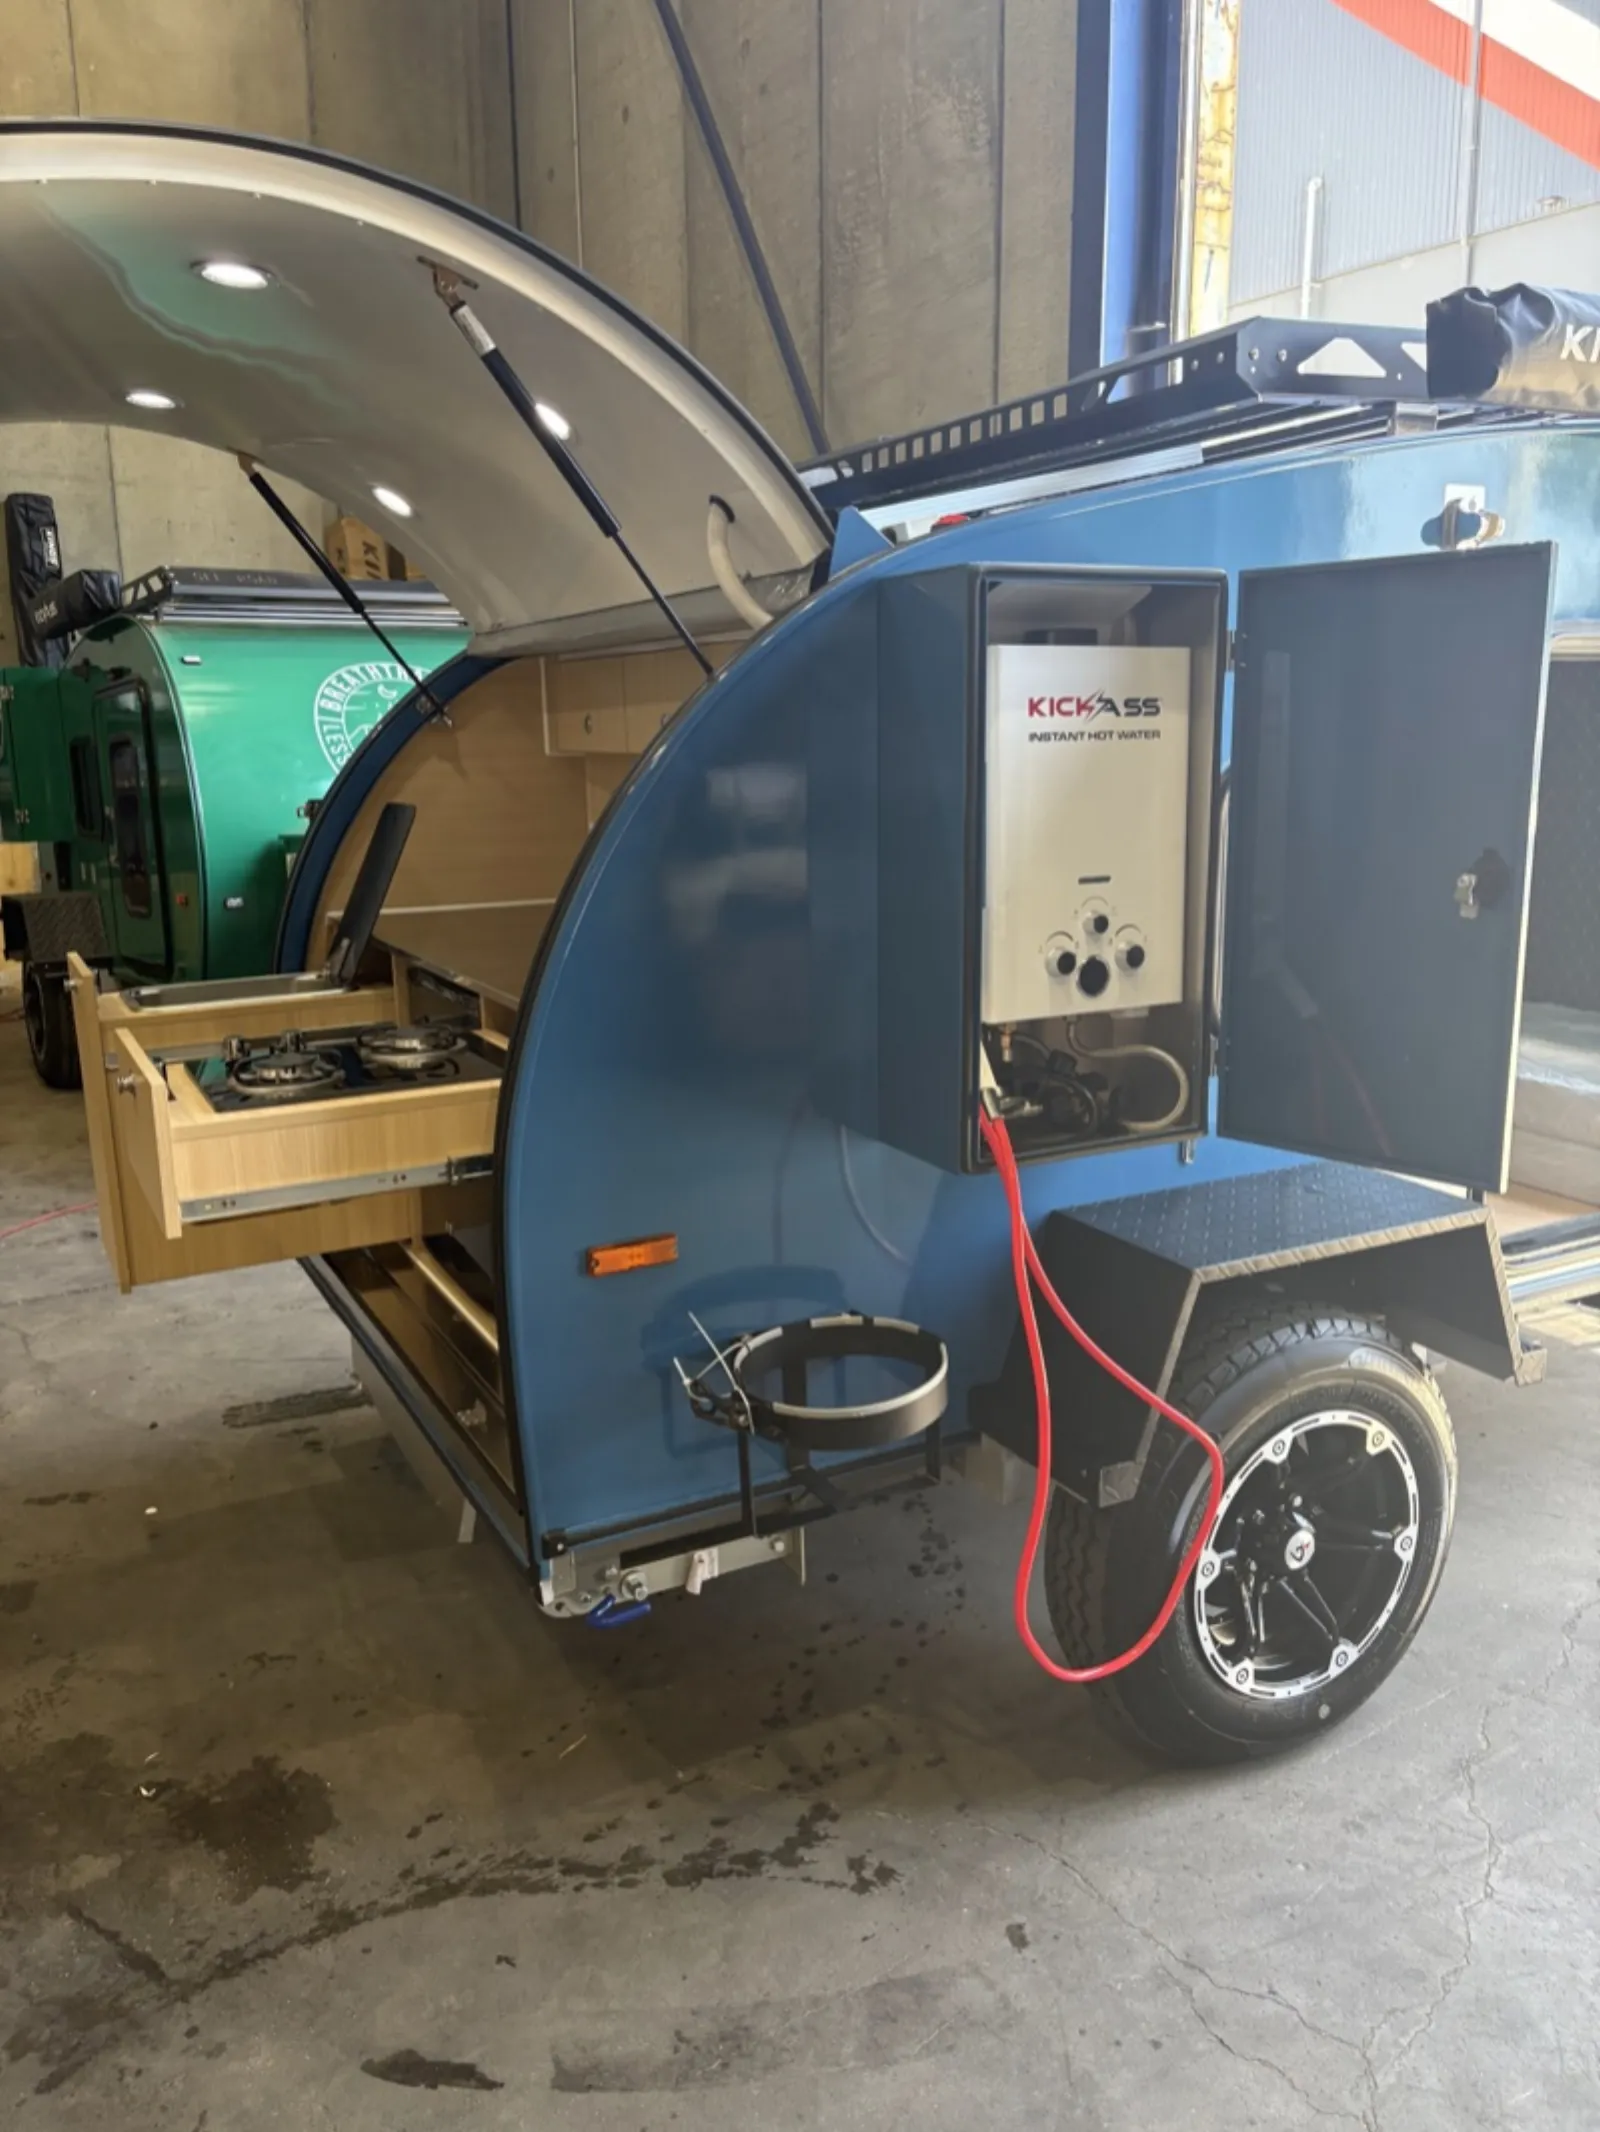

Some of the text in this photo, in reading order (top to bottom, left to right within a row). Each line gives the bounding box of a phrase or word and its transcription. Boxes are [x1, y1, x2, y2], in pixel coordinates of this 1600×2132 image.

[1028, 692, 1161, 721] KICKASS
[1028, 729, 1161, 743] INSTANT HOT WATER
